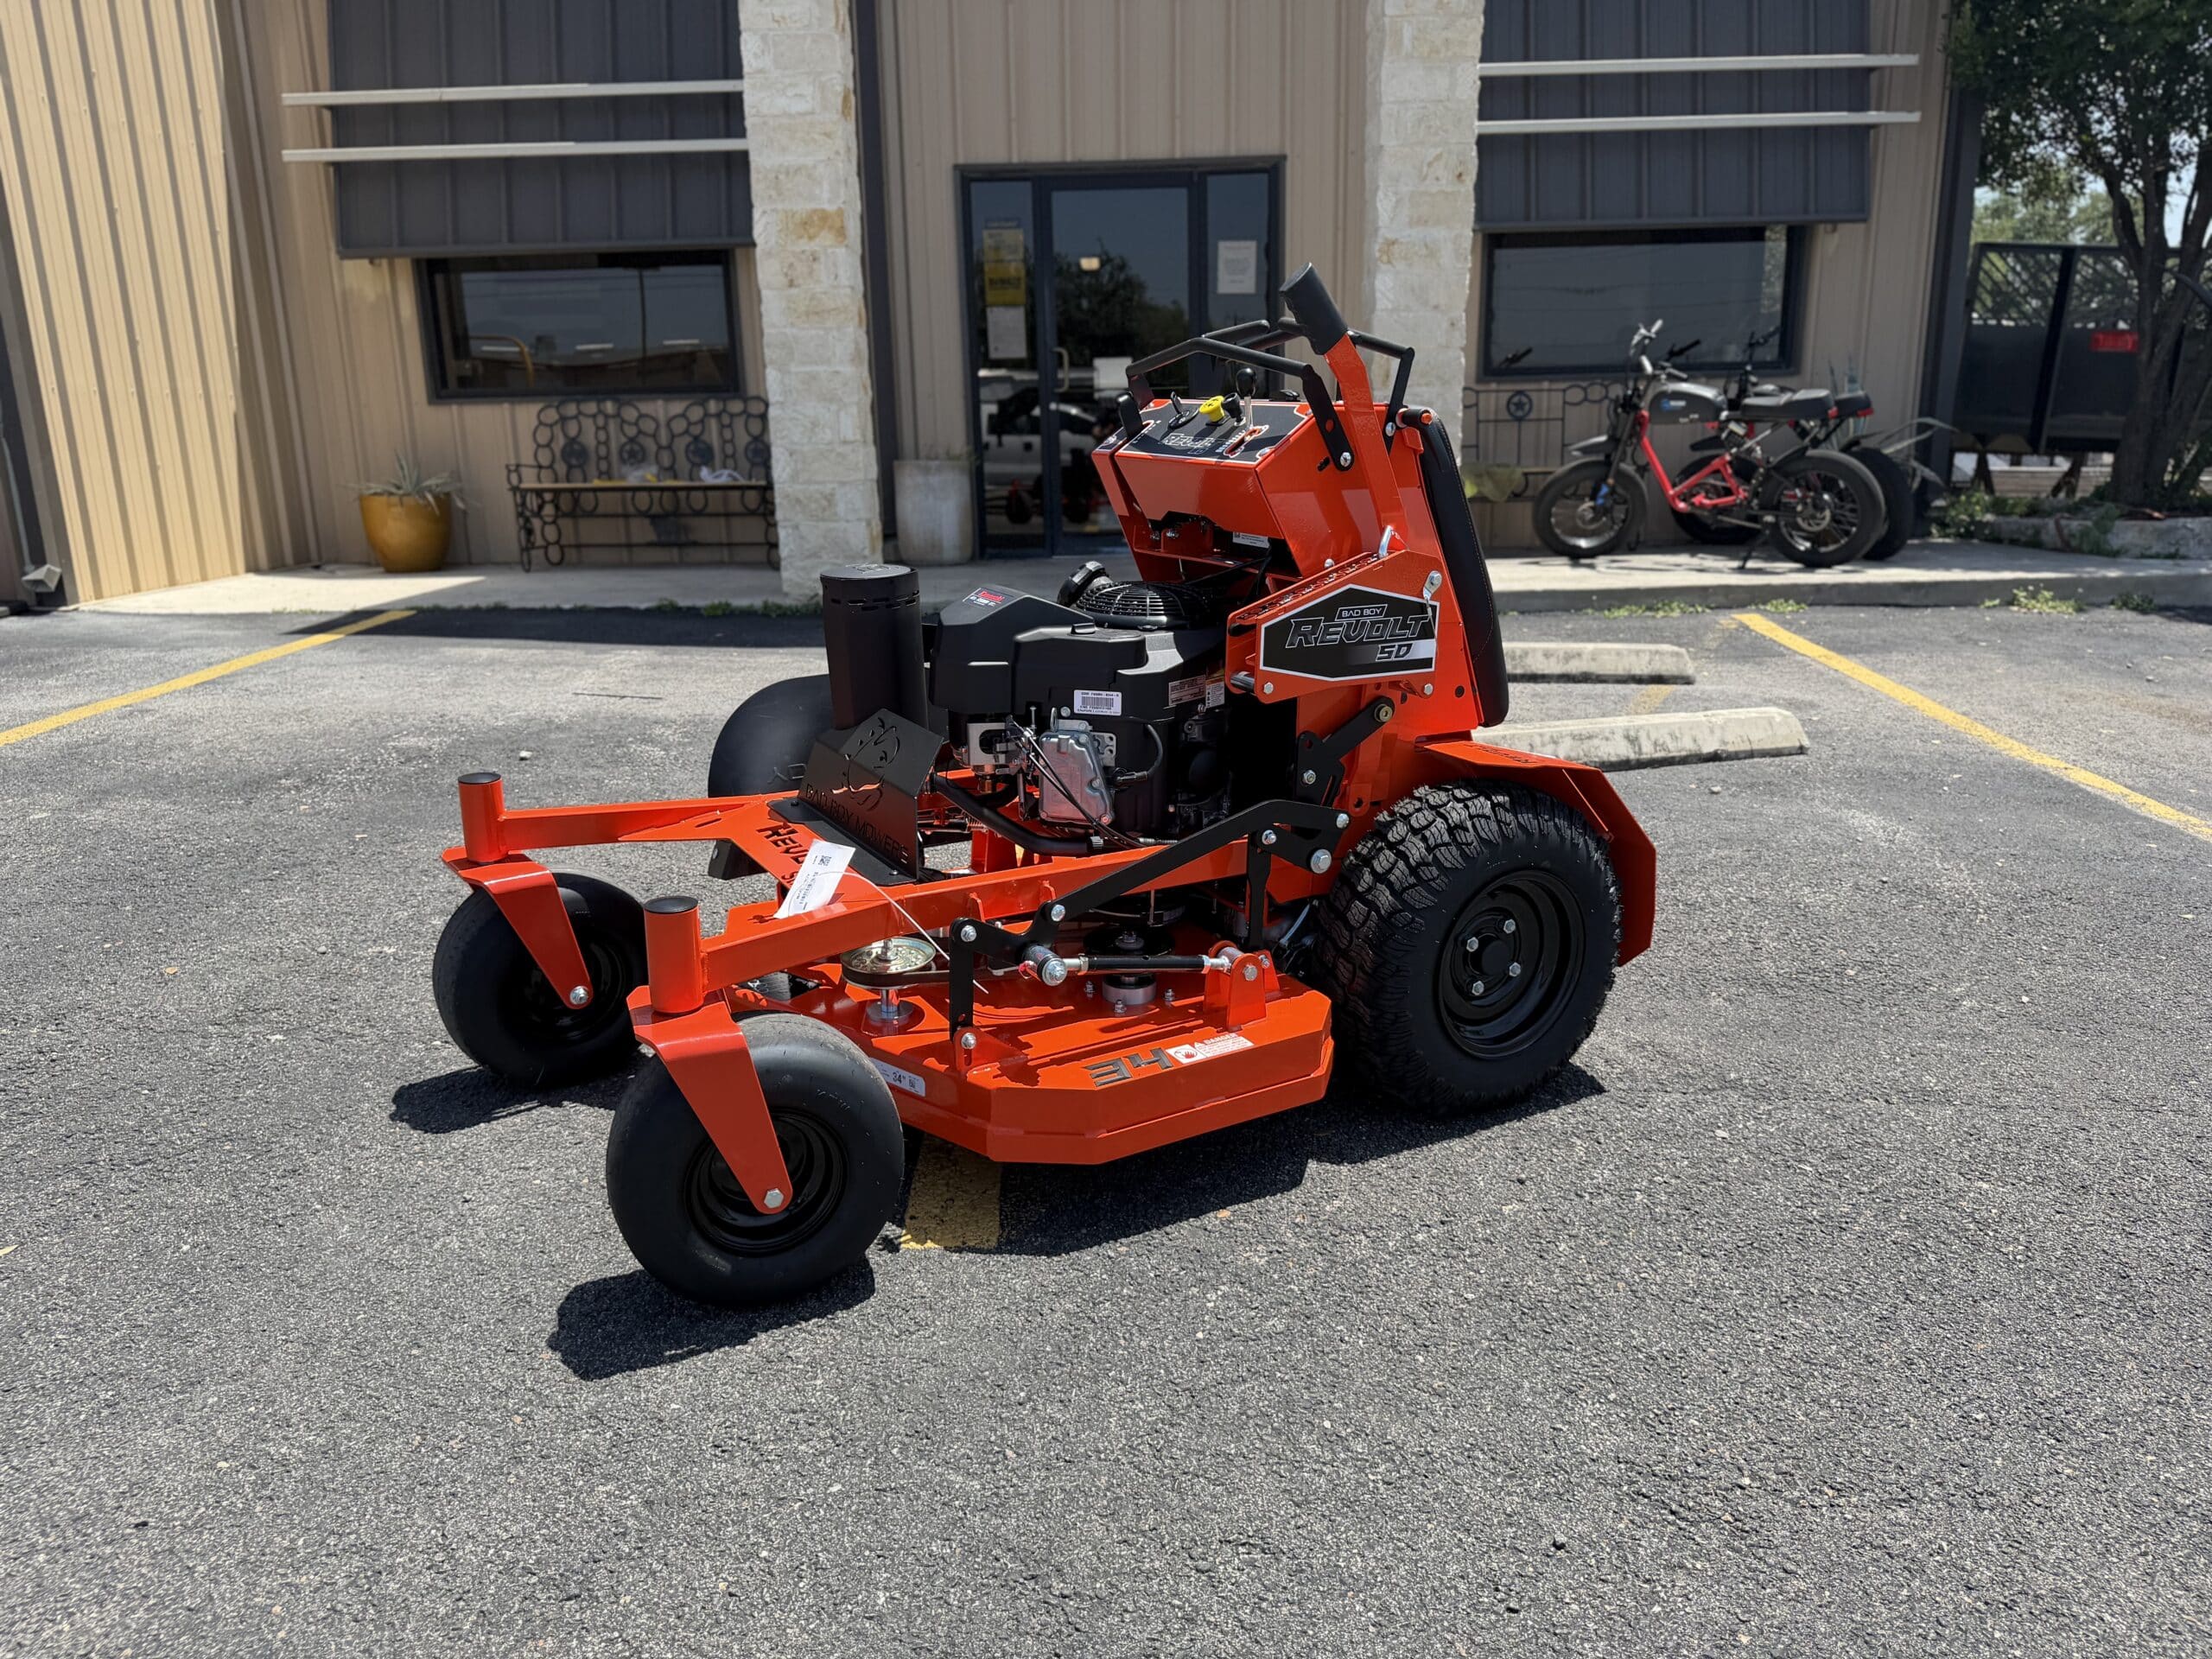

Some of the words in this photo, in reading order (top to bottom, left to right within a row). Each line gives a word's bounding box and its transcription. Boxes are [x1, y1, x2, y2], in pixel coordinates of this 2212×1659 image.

[1363, 607, 1382, 616] BOY
[1286, 614, 1430, 648] REVOLT
[806, 783, 829, 810] BAD
[830, 798, 854, 823] BOY
[1083, 1047, 1174, 1087] 34
